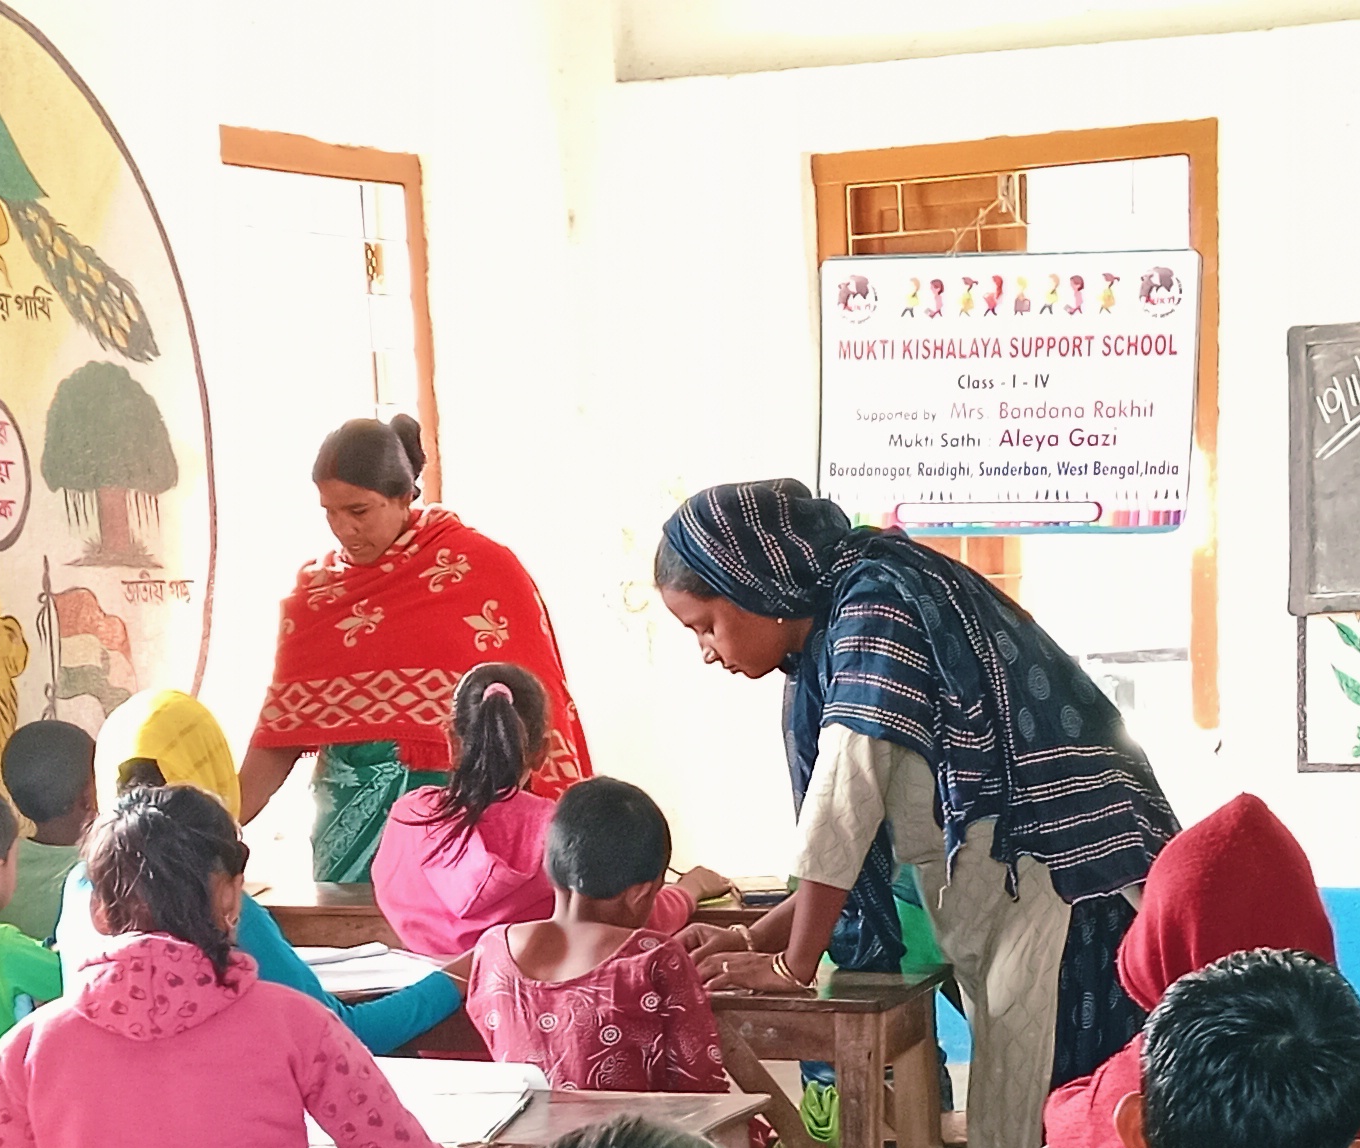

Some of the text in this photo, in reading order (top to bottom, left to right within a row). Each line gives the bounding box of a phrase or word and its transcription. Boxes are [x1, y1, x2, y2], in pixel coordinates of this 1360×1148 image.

[839, 333, 1178, 361] MUKTI KISHALAYA SUPPORT SCHOOL
[957, 374, 995, 389] Class
[1034, 373, 1050, 388] IV
[856, 408, 918, 423] Supported
[923, 409, 937, 424] by
[999, 400, 1085, 420] Bandana
[1094, 399, 1154, 419] Rakhit
[888, 433, 934, 448] Mukti
[940, 432, 981, 448] Sathi
[999, 428, 1059, 452] Aleya
[1069, 426, 1118, 447] Gazi
[917, 461, 974, 481] Raidighi,
[979, 460, 1052, 478] Sunderban,
[1056, 460, 1088, 476] West
